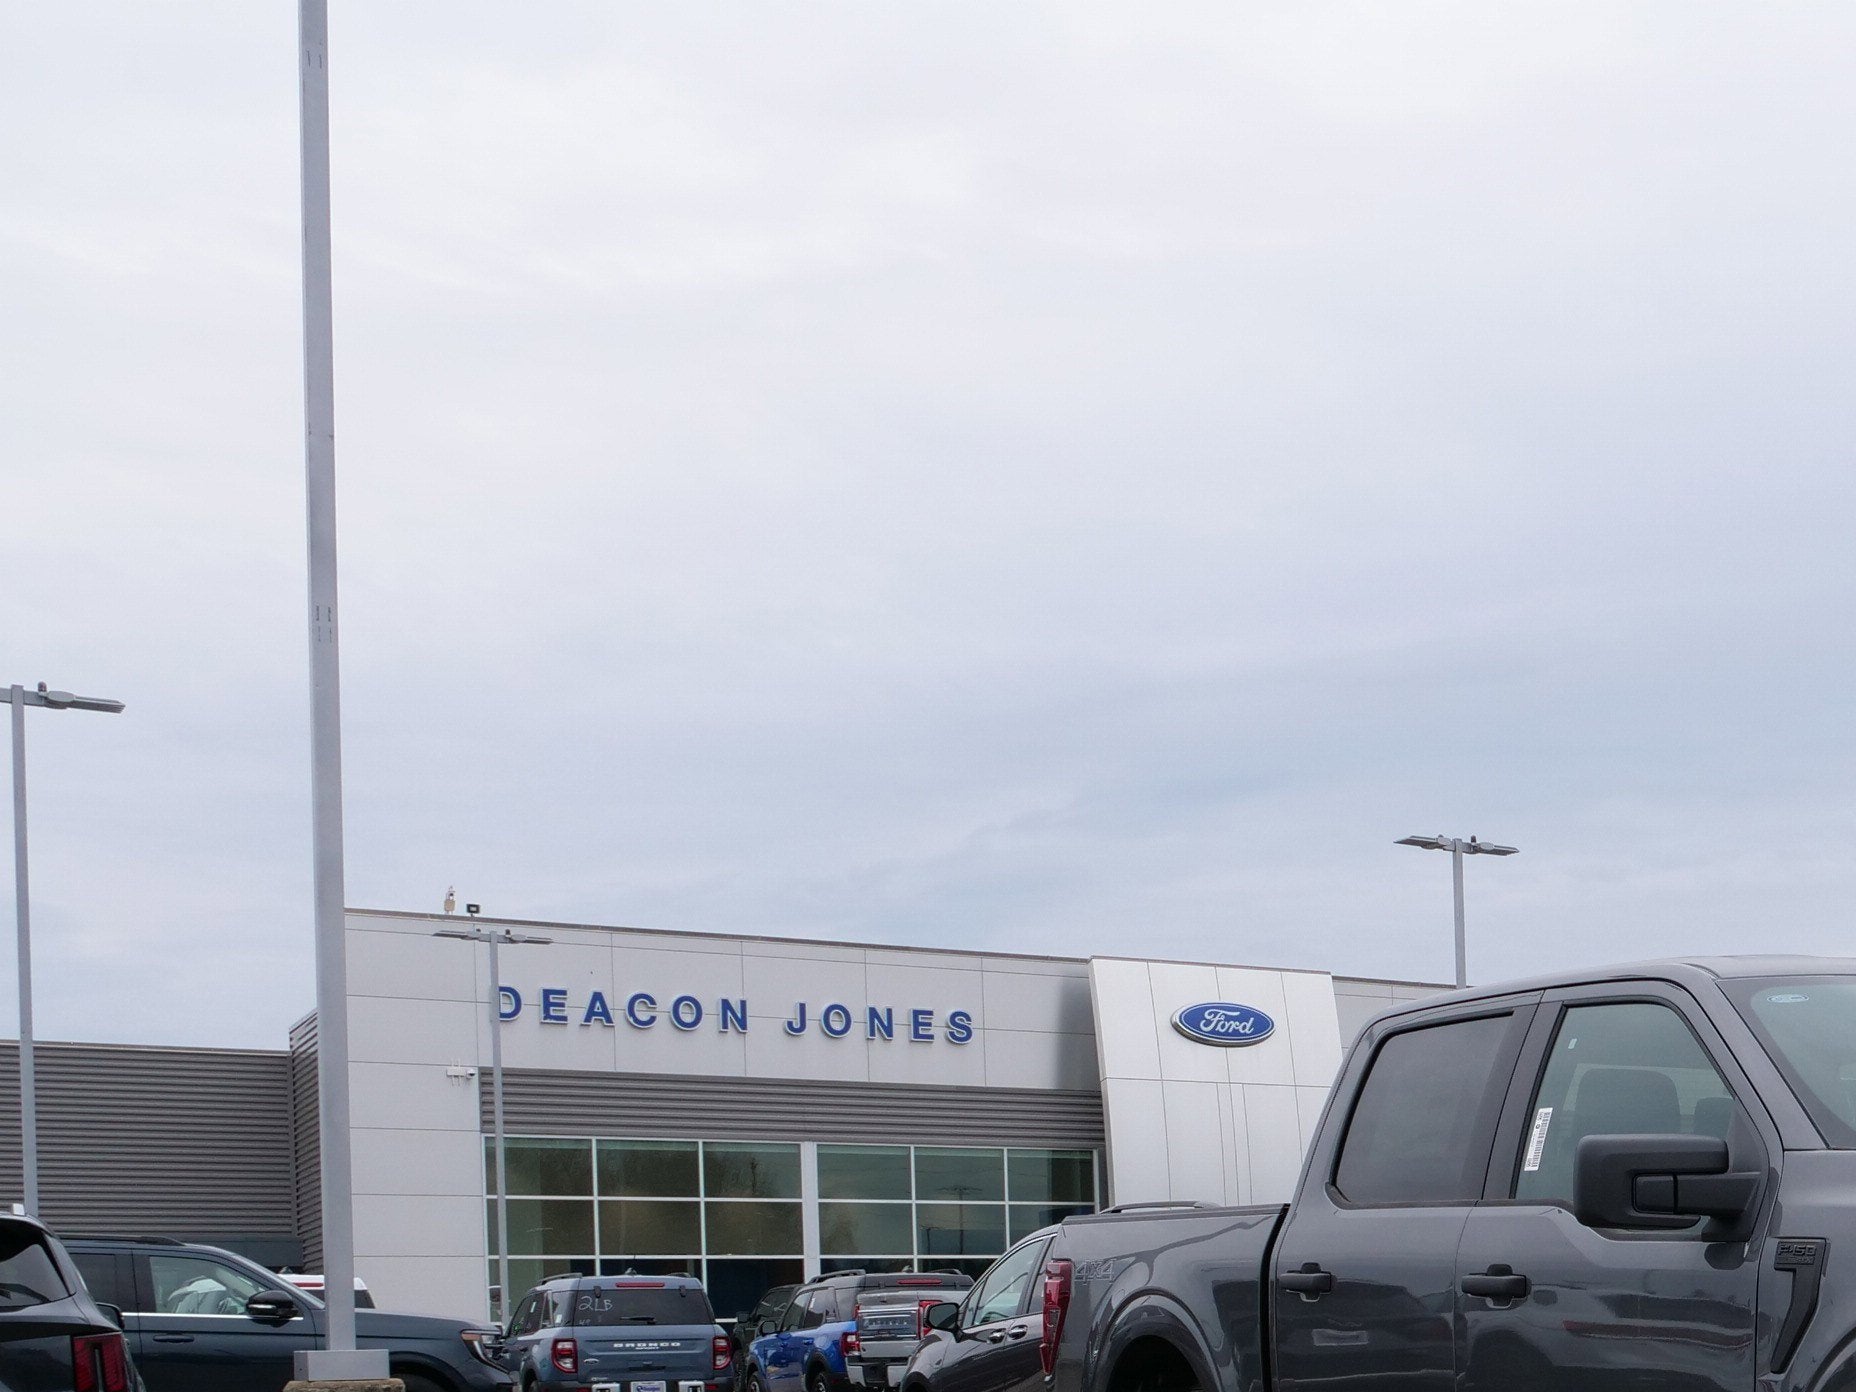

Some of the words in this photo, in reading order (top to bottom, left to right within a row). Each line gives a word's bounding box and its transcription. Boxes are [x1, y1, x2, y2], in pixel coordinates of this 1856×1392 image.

[498, 986, 749, 1034] DEACON
[784, 1002, 974, 1045] JONES
[1200, 1008, 1255, 1034] Ford
